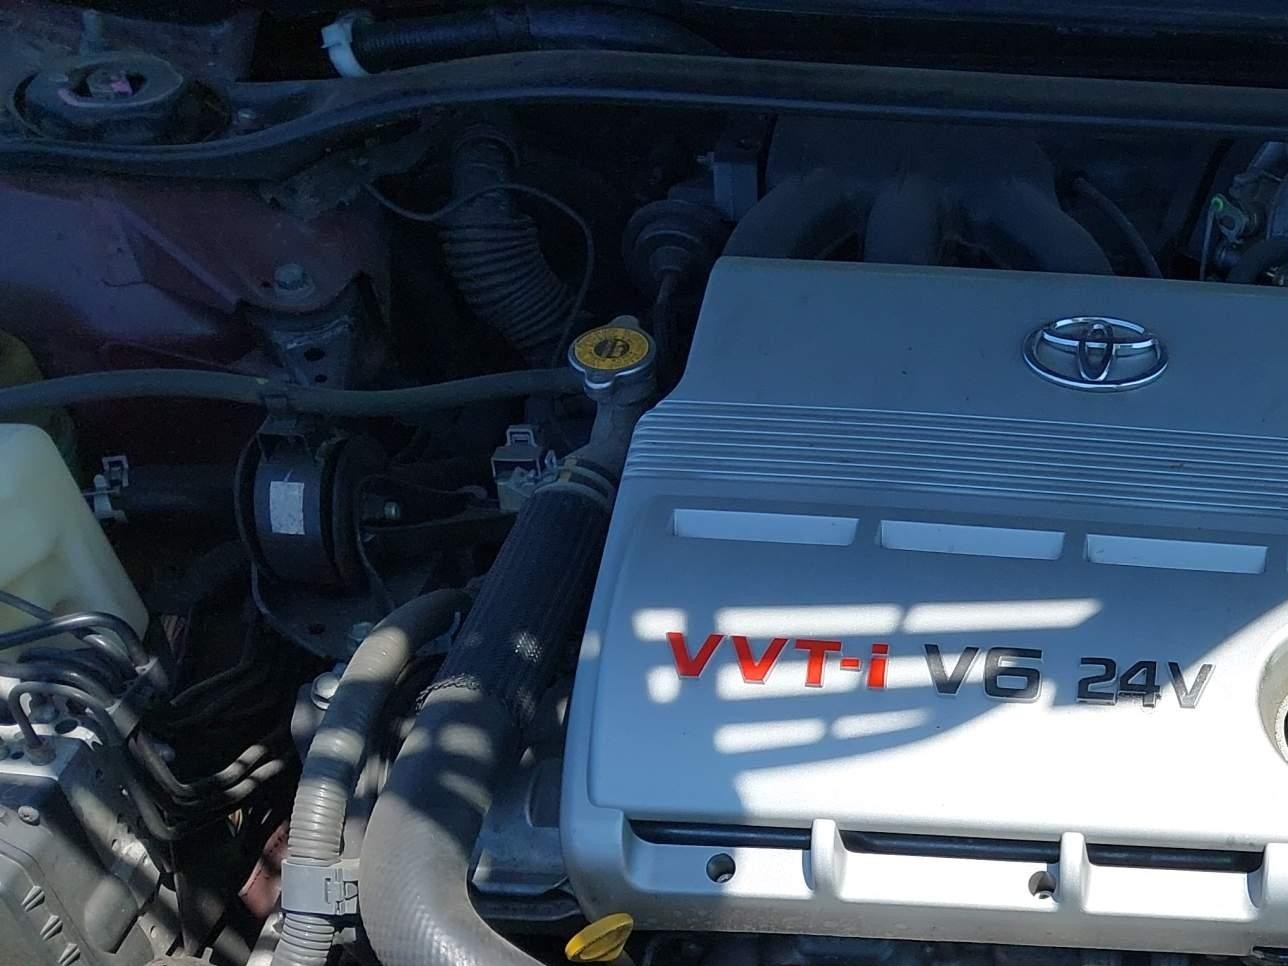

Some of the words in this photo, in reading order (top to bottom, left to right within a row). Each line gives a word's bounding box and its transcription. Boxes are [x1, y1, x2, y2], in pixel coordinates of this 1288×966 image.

[666, 632, 889, 691] VVT-i
[924, 643, 1043, 703] V6
[1077, 656, 1216, 709] 24V
